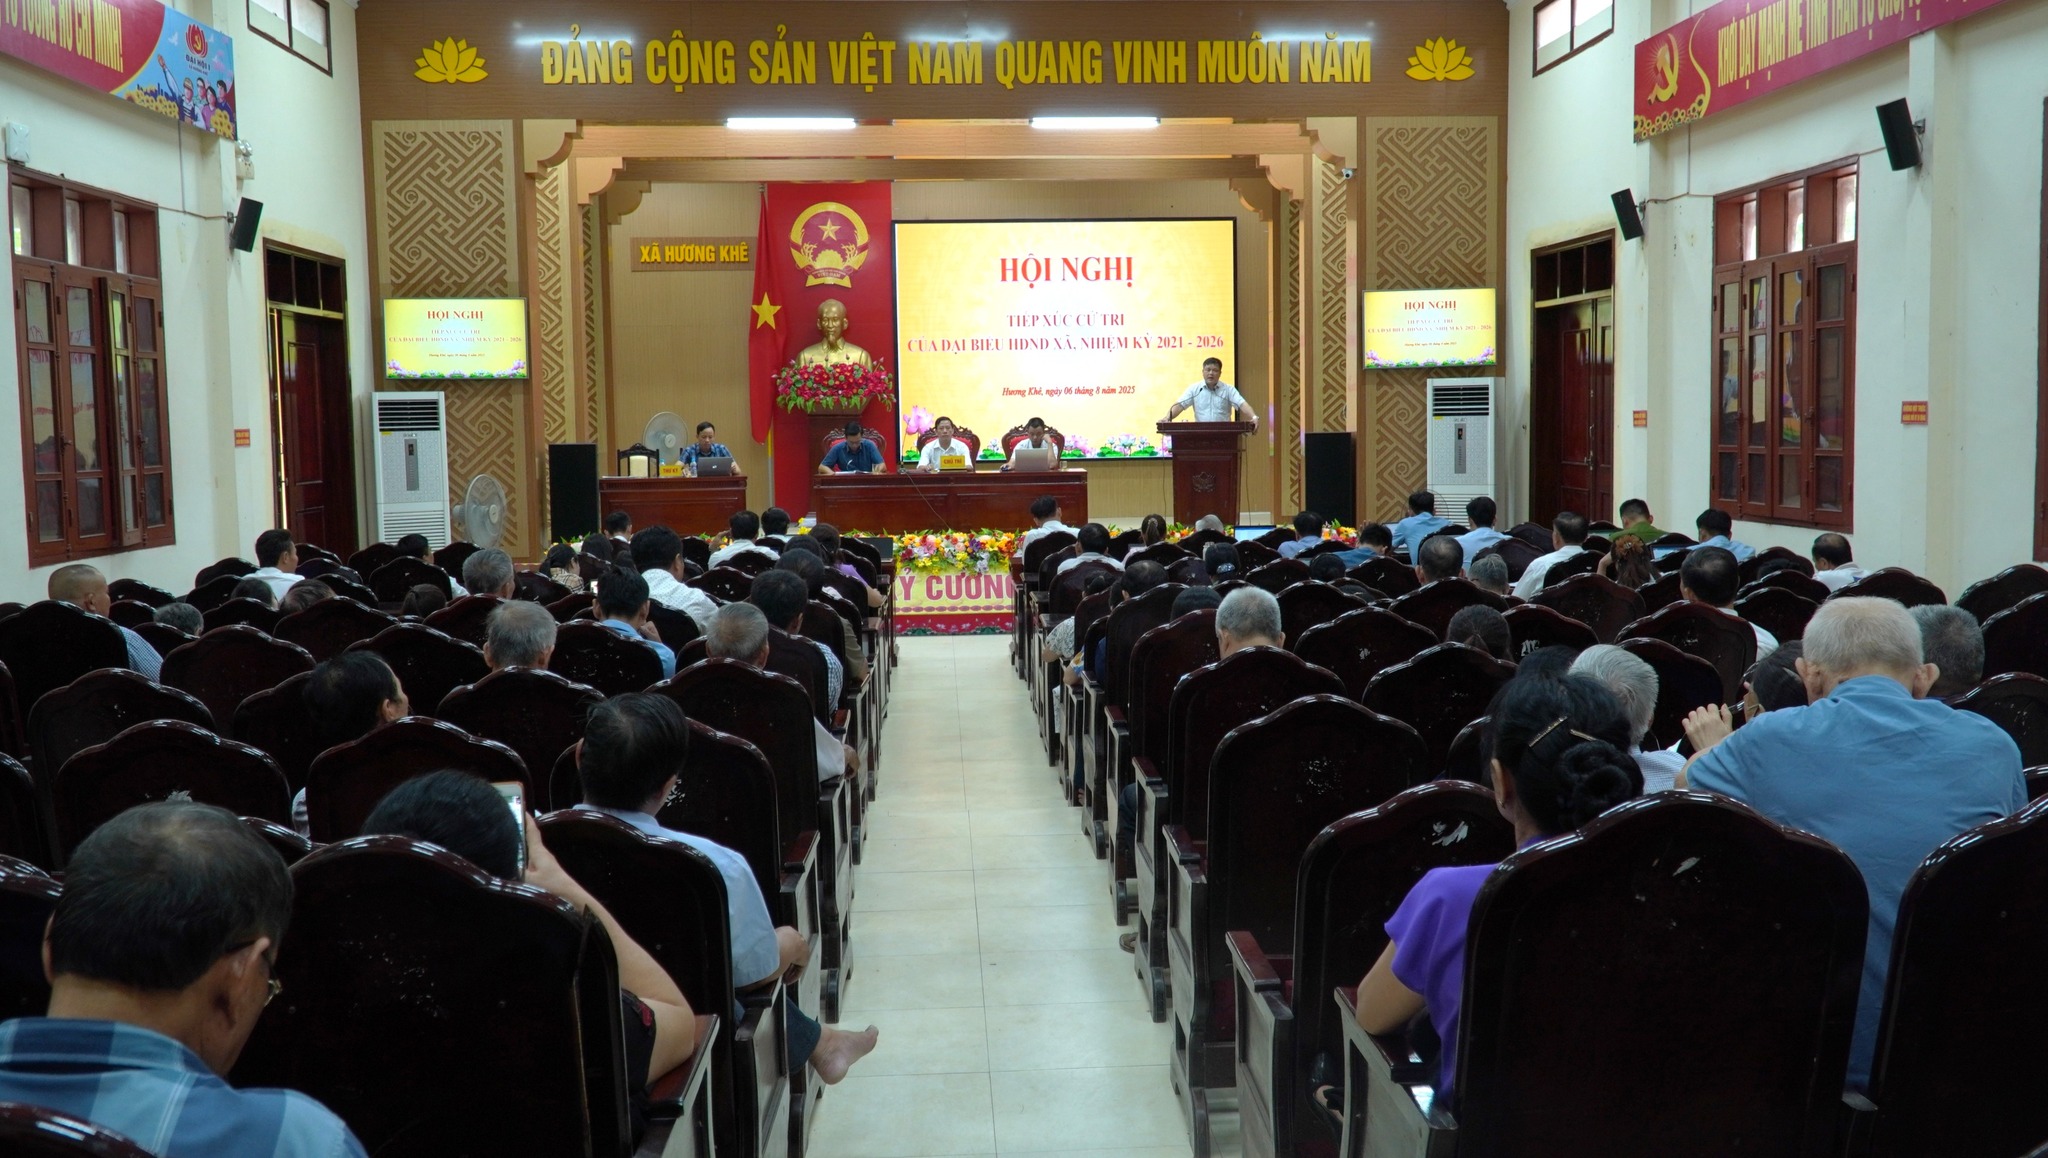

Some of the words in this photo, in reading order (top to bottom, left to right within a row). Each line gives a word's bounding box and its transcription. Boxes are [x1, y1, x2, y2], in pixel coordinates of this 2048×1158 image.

[93, 0, 124, 73] MINH!
[541, 23, 633, 85] ĐẢNG
[645, 29, 736, 93] CỘNG
[749, 24, 816, 85] SẢN
[828, 32, 896, 93] VIỆT
[908, 40, 983, 85] NAM
[995, 40, 1103, 90] QUANG
[1112, 40, 1187, 84] VINH
[1198, 31, 1290, 84] MUÔN
[1300, 31, 1371, 84] NĂM
[640, 242, 661, 263] XÃ
[664, 243, 717, 263] HƯƠNG
[719, 241, 750, 263] KHÊ
[1000, 253, 1052, 289] HỘI
[1061, 256, 1133, 288] NGHỊ
[1100, 313, 1125, 327] TRI
[1157, 335, 1184, 349] 2021
[1196, 335, 1224, 348] 2026
[1002, 387, 1027, 398] Hương
[1045, 386, 1063, 397] ngày
[1064, 386, 1073, 395] 06
[1074, 386, 1094, 397] tháng
[1095, 386, 1101, 395] 8
[1102, 386, 1117, 395] năm
[1118, 385, 1136, 395] 2025
[895, 566, 916, 601] Ỷ
